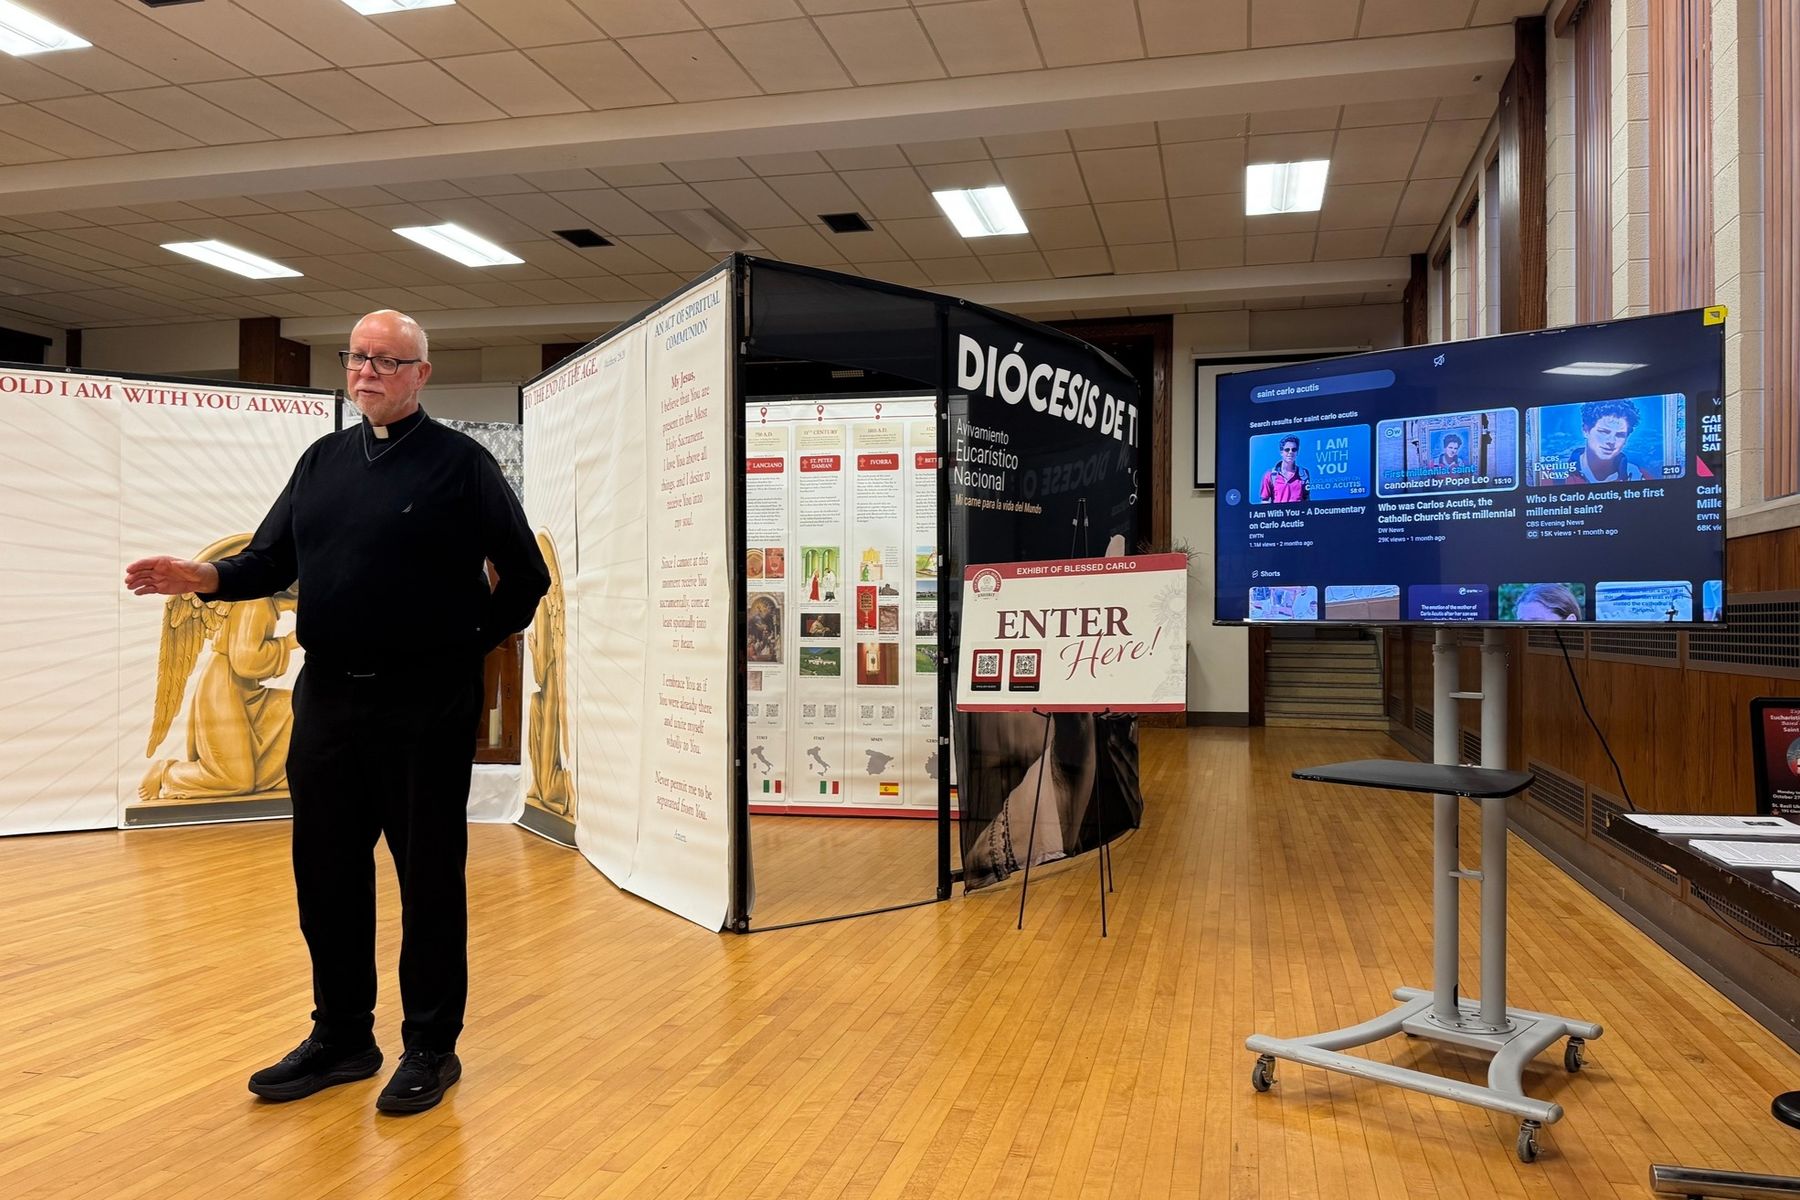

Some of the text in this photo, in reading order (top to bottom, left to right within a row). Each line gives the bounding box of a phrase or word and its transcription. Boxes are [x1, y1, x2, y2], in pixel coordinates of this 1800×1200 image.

[655, 290, 720, 338] AN ACT OF SPIRITUAL
[665, 318, 708, 351] COMMUNION
[671, 374, 680, 391] My
[524, 393, 533, 410] TO
[534, 385, 545, 405] THE
[545, 380, 558, 399] END
[558, 374, 567, 392] OF
[958, 333, 1139, 448] DIÓCESIS DE T
[1257, 383, 1320, 398] saint carlo acutis
[61, 381, 68, 397] I
[74, 383, 112, 399] AM
[122, 388, 187, 407] WITH
[194, 393, 240, 411] YOU
[246, 397, 330, 419] ALWAYS,
[1249, 410, 1358, 429] Search results for saint carlo acutis
[956, 418, 1009, 445] Avivamiento
[1317, 437, 1348, 451] I AM
[956, 438, 1018, 470] Eucarístico
[1316, 449, 1349, 463] WITH
[1317, 462, 1347, 475] YOU
[1384, 469, 1405, 479] First
[1406, 466, 1450, 477] millennial
[1534, 460, 1577, 473] Evening
[1663, 466, 1680, 475] 2:10
[954, 466, 1005, 491] Nacional
[1384, 475, 1489, 489] canonized by Pope Leo
[1541, 470, 1570, 480] News
[1305, 481, 1361, 491] CARLO ACUTIS
[1526, 487, 1665, 504] Who is Carlo Acutis, the first
[955, 493, 963, 506] Mi
[981, 499, 995, 511] para
[996, 499, 1002, 510] la
[1002, 500, 1014, 511] vida
[1015, 502, 1024, 513] del
[1024, 502, 1042, 514] Mundo
[1378, 498, 1493, 511] Who was Carlos Acutis, the
[1526, 504, 1604, 517] millennial saint?
[1253, 510, 1266, 518] Am
[1267, 509, 1284, 517] With
[1285, 509, 1300, 517] You
[1314, 505, 1366, 515] Documentary
[1378, 508, 1516, 523] Catholic Church's first millennial
[1697, 513, 1719, 521] EWTN
[1260, 521, 1279, 529] Carlo
[1280, 519, 1304, 528] Acutis
[1526, 520, 1539, 528] CBS
[1540, 519, 1565, 529] Evening
[1697, 524, 1711, 532] 68K
[1582, 528, 1604, 536] month
[1605, 528, 1618, 537] ago
[1016, 561, 1137, 575] EXHIBIT OF BLESSED CARLO
[994, 606, 1133, 640] ENTER
[1059, 625, 1162, 681] Here!
